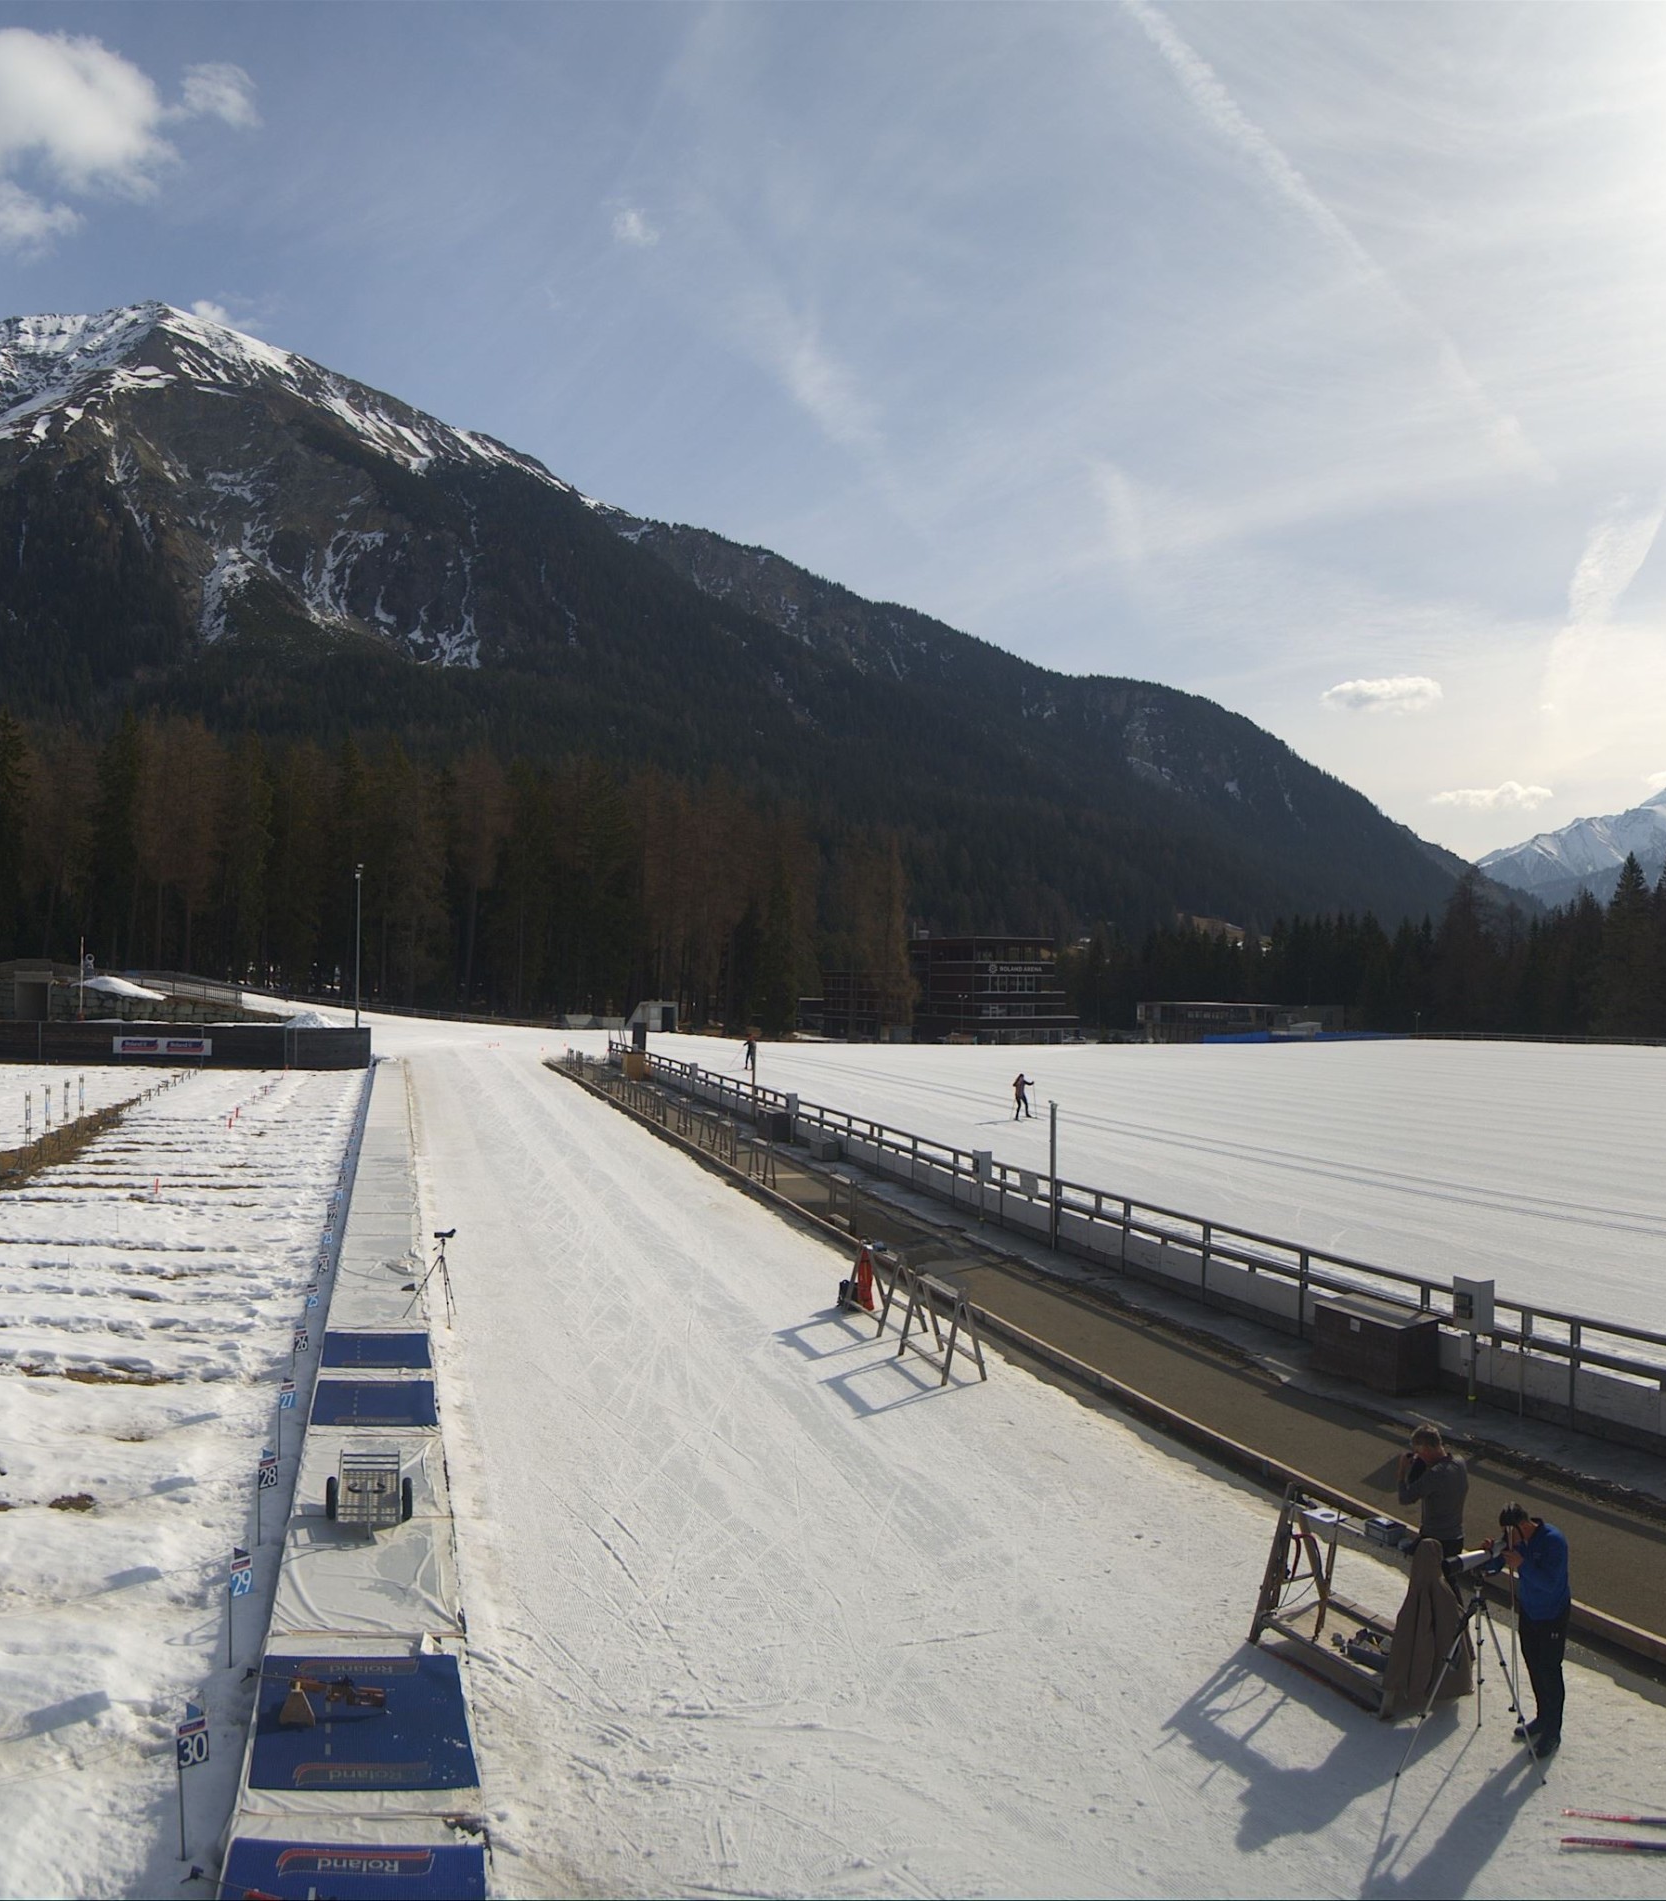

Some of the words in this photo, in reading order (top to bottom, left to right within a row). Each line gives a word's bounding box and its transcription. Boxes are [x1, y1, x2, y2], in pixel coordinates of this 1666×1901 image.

[324, 1233, 332, 1243] 23
[319, 1261, 328, 1273] 24
[308, 1295, 318, 1307] 25
[295, 1337, 307, 1351] 26
[281, 1393, 294, 1409] 27
[259, 1467, 277, 1488] 28
[232, 1570, 251, 1597] 29
[179, 1732, 208, 1767] 30
[317, 1857, 399, 1873] Roland
